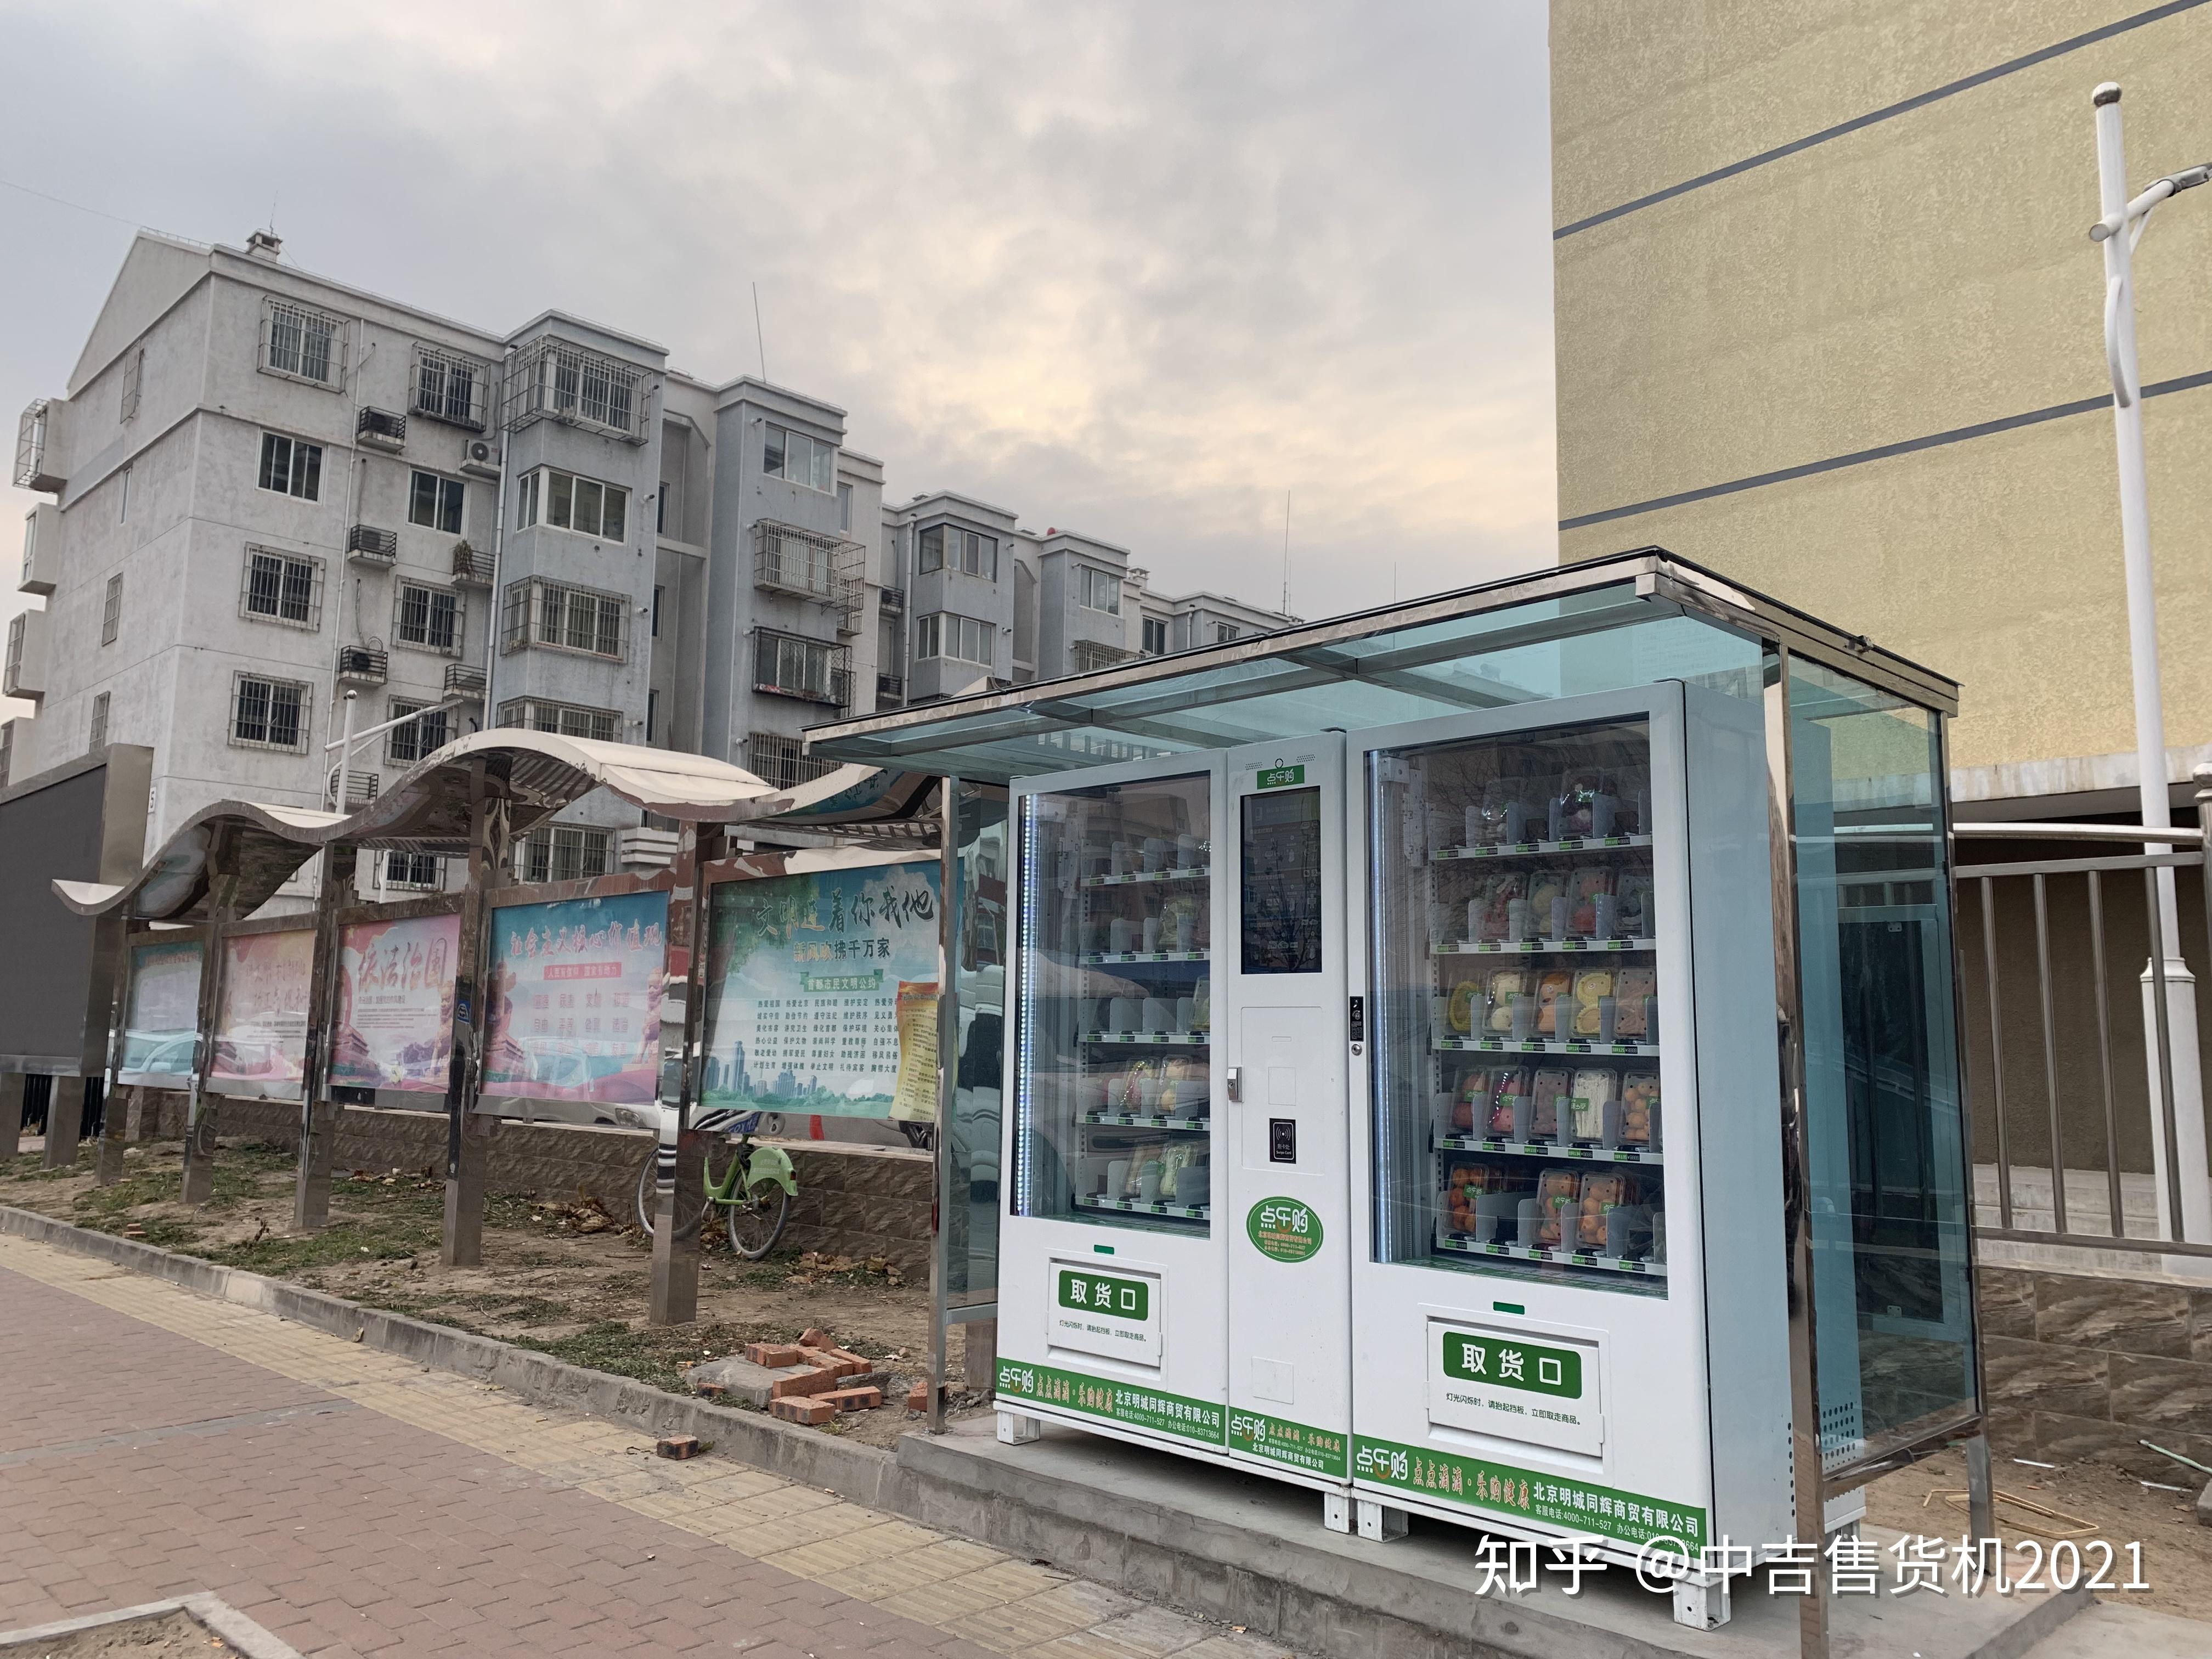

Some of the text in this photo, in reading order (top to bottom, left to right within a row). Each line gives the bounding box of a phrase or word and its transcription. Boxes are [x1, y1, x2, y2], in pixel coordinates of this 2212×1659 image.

[511, 918, 662, 958] 社会主义核心价值观
[794, 938, 890, 962] 新风吹拂千万家
[359, 937, 447, 992] 依法治国
[807, 977, 876, 990] 首都市民文明公约
[873, 1037, 898, 1046] 自强不息
[873, 1051, 898, 1059] 移风易俗
[1070, 1279, 1136, 1311] 取货口
[1462, 1343, 1561, 1386] 取货口
[1115, 1389, 1220, 1428] 北京明城同辉商贸有限公司
[1116, 1408, 1220, 1440] 客服电话:4000-711-527 办公电话:010-83713664
[1252, 1442, 1324, 1470] 北京明城同辉商贸有限公司
[1533, 1481, 1699, 1537] 北京明城同辉商贸有限公司
[1536, 1504, 1612, 1531] 客服电话:4000-711-527
